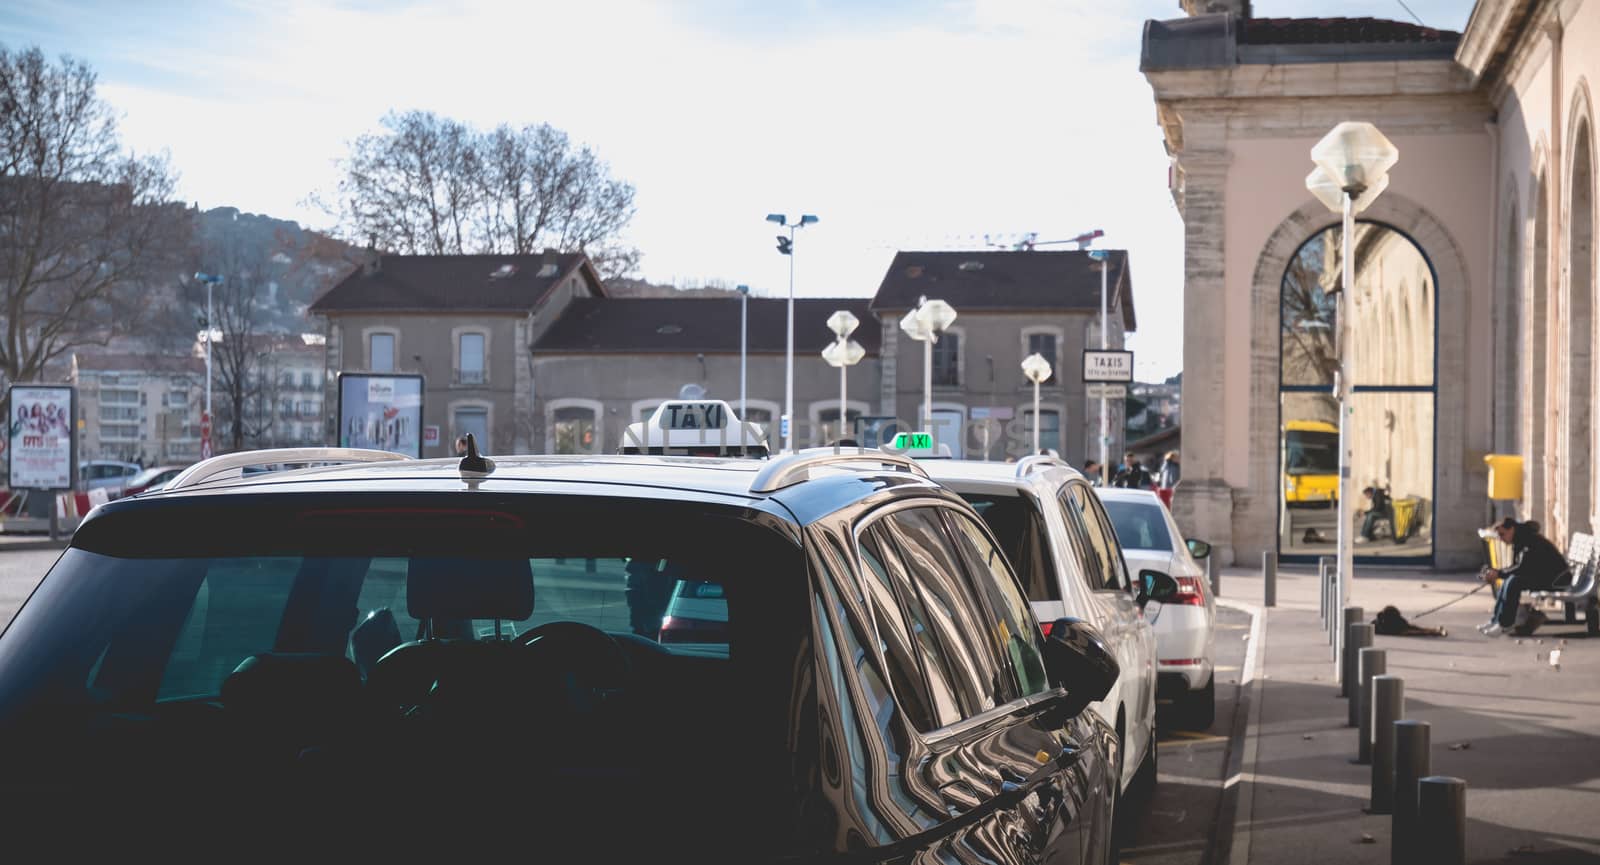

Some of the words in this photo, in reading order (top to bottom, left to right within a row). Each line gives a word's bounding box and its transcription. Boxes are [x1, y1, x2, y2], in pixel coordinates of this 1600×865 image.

[1094, 357, 1123, 368] TAXIS
[667, 404, 721, 428] TAXI
[899, 434, 929, 449] TAXI
